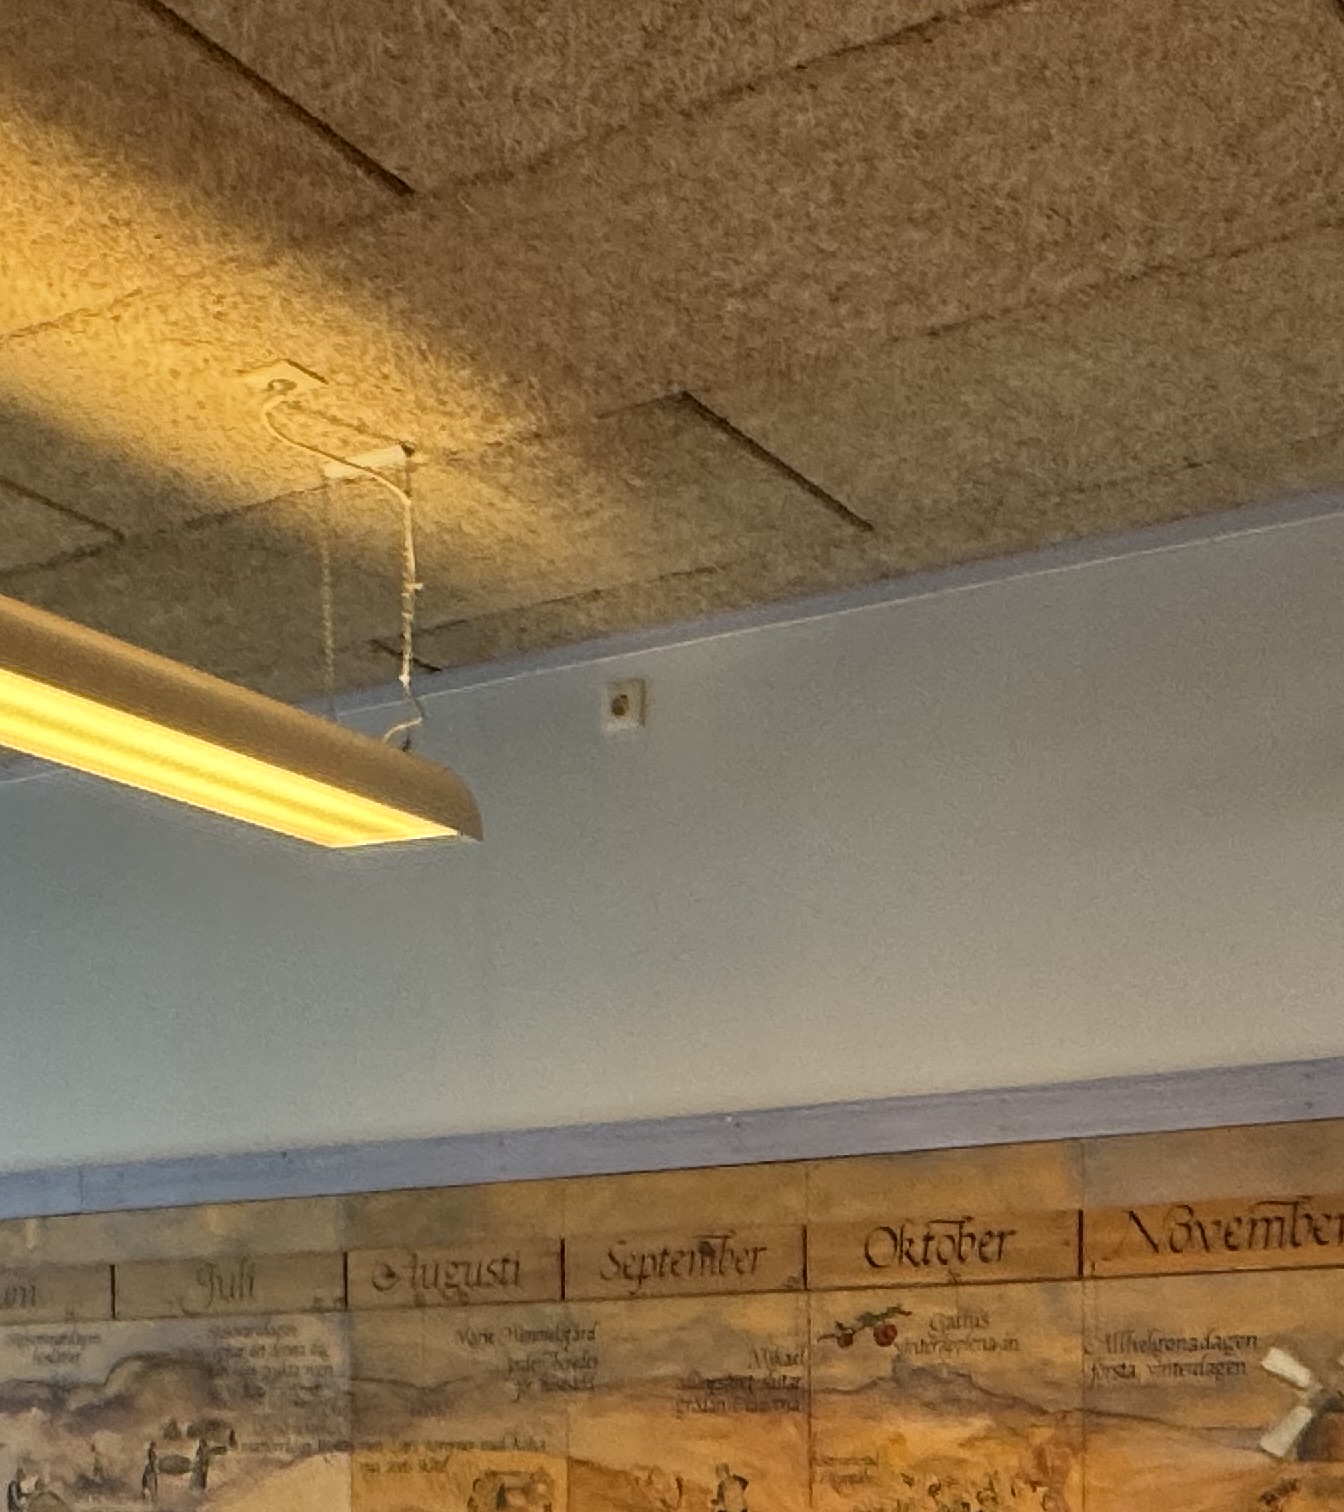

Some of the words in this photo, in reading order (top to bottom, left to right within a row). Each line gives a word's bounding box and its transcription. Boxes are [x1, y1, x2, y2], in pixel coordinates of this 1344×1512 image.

[598, 1229, 768, 1297] September
[862, 1214, 1017, 1270] Oktober
[369, 1250, 522, 1307] Augusti
